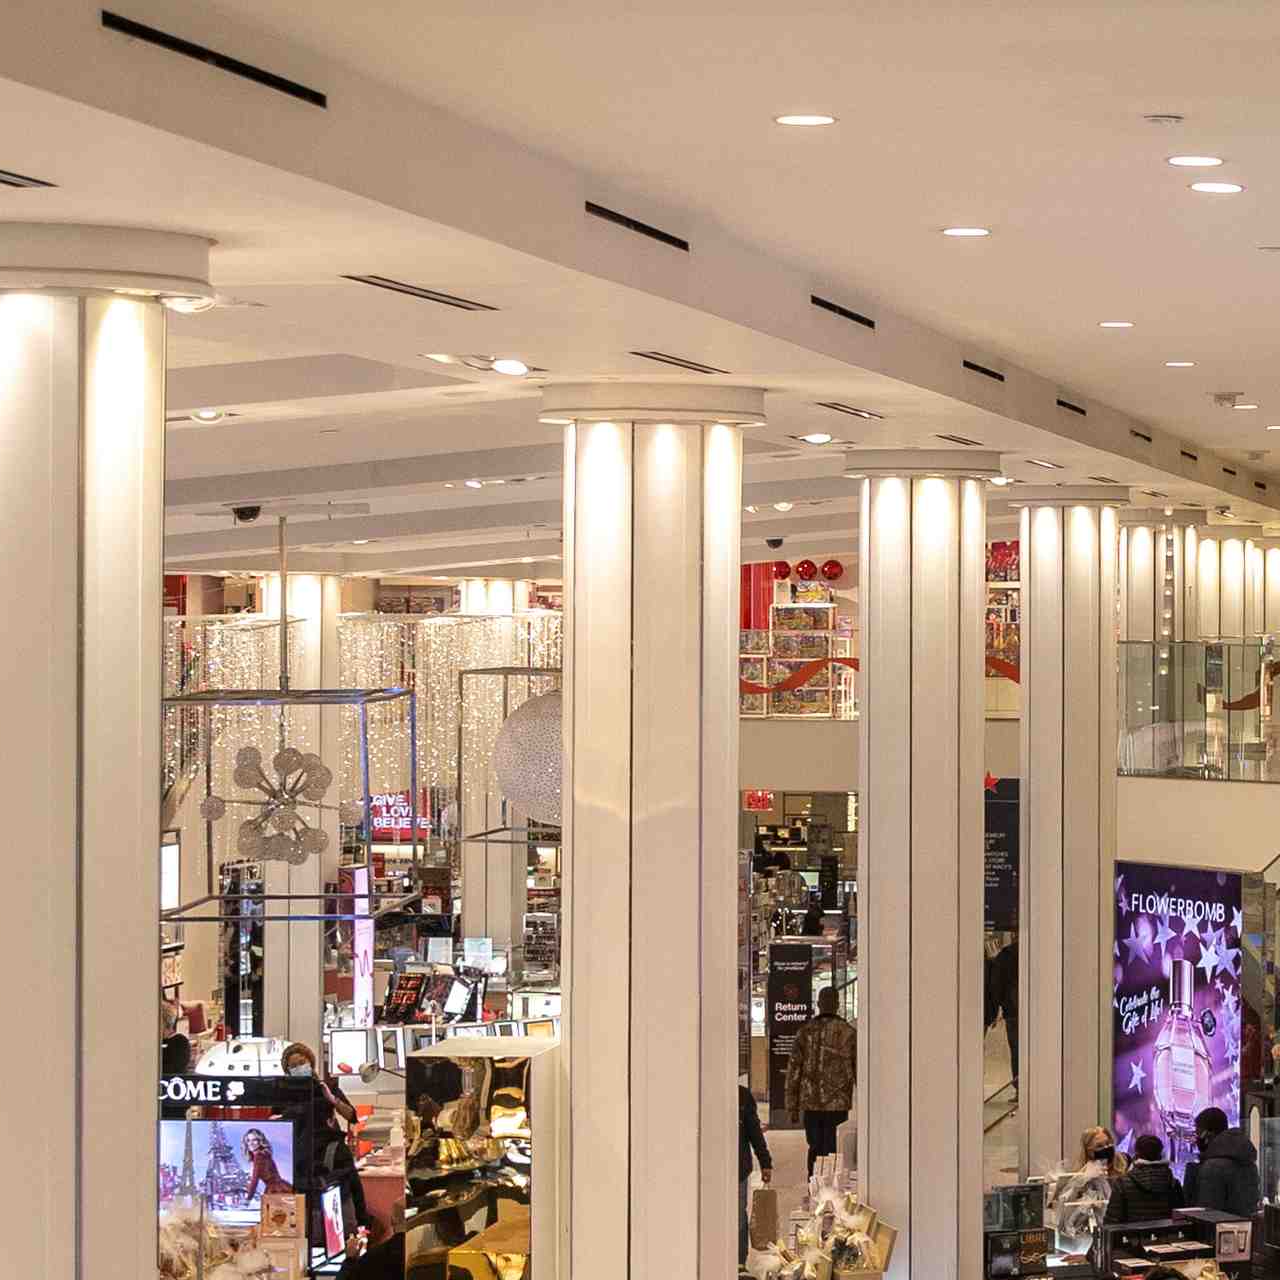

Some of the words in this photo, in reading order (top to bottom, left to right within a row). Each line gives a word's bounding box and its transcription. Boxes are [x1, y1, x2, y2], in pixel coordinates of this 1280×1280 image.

[1131, 893, 1226, 921] FLOWERBOMB
[775, 1002, 808, 1011] Return
[775, 1012, 808, 1021] Center
